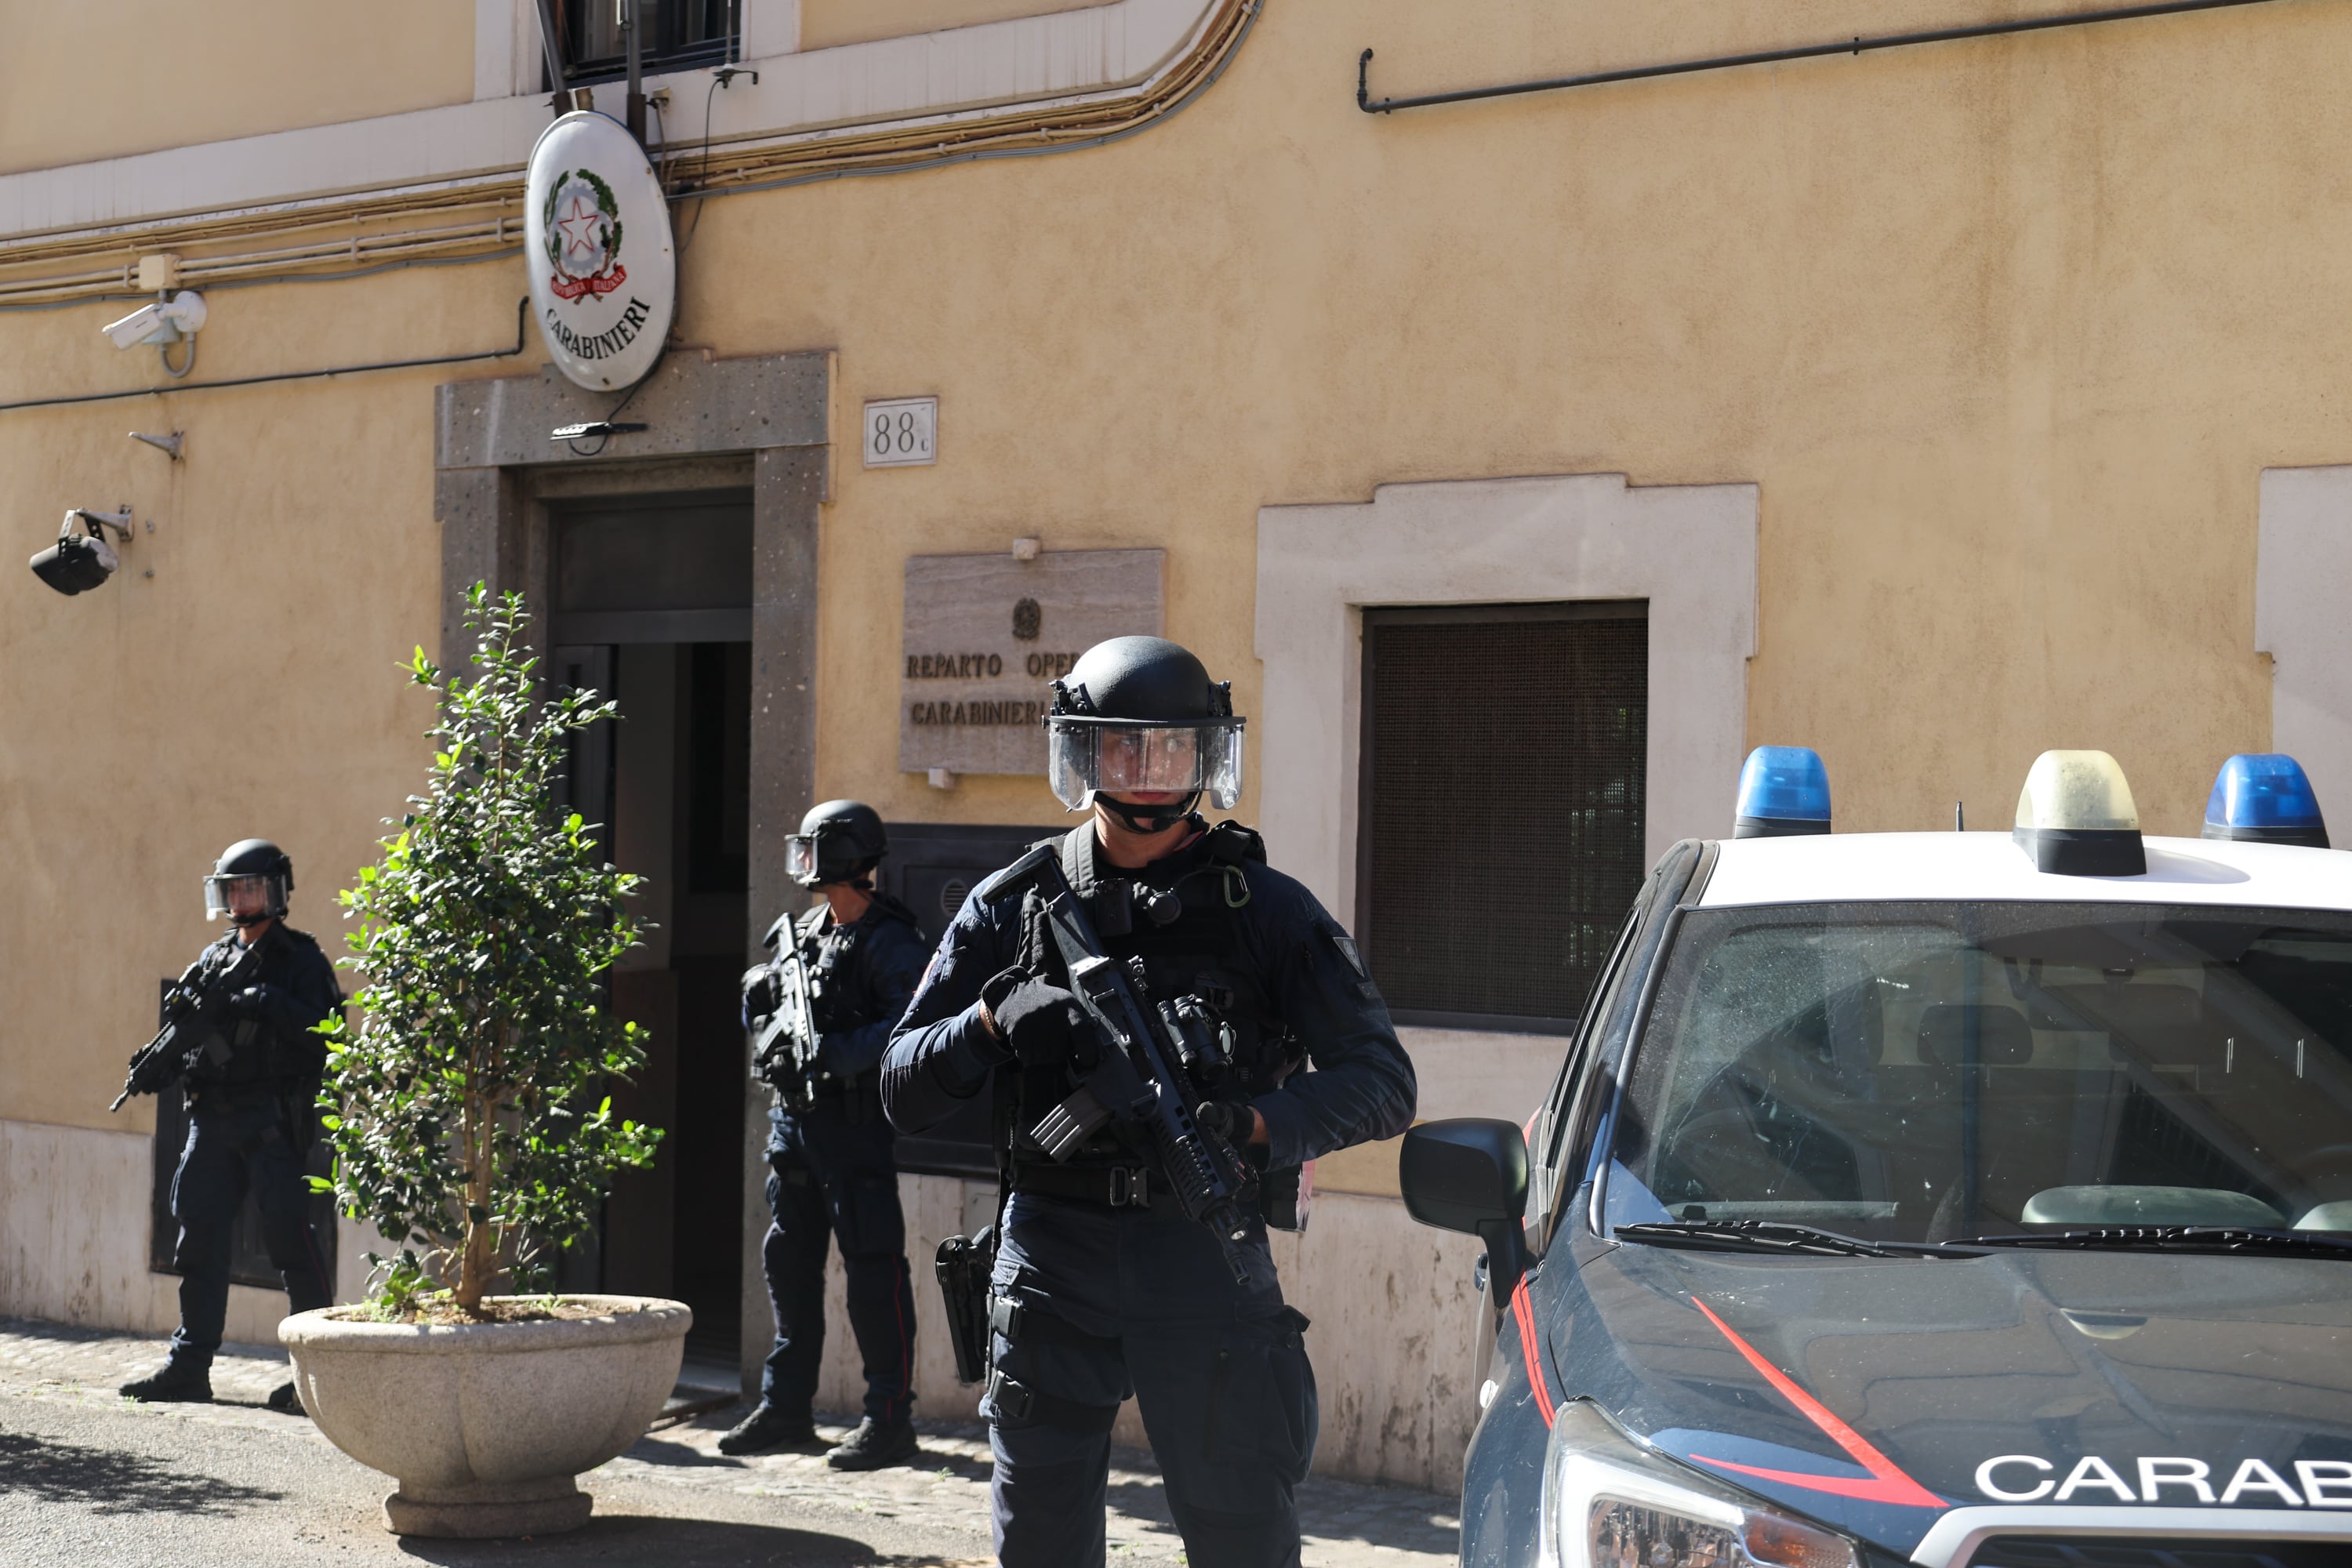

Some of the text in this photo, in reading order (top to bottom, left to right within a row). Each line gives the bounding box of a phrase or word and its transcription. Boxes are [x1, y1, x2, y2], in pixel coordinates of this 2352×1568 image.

[546, 296, 650, 359] CARABINIERI
[906, 652, 1002, 678] REPARTO
[911, 701, 1045, 726] CARABINIERI
[1975, 1455, 2352, 1506] CARAB
